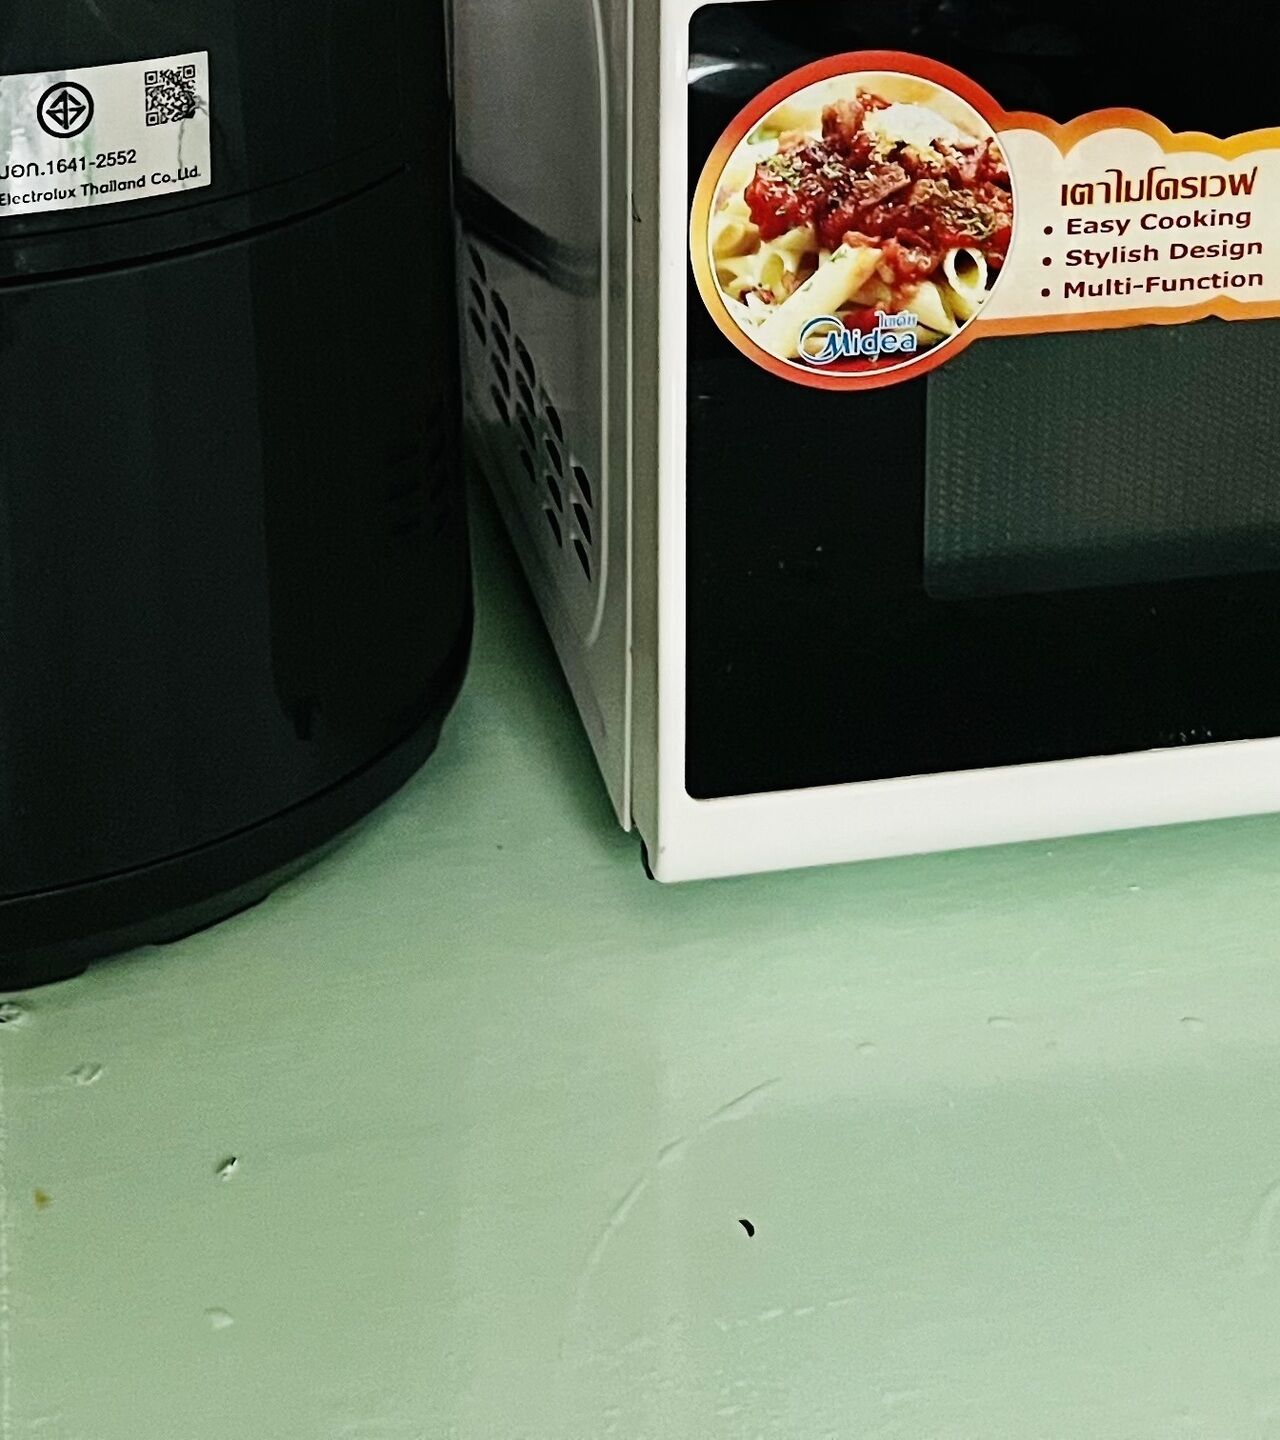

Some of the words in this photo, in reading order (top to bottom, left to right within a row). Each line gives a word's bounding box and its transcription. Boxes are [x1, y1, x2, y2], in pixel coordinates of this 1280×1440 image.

[80, 175, 146, 197] Thailand
[1061, 166, 1258, 206] เตาไมโครเวฟ
[1067, 217, 1131, 237] Easy
[1140, 209, 1252, 231] Cooking
[1065, 244, 1159, 268] Stylish
[1170, 239, 1263, 261] Design
[1064, 271, 1263, 298] Multi-Function
[799, 314, 918, 366] Midea
